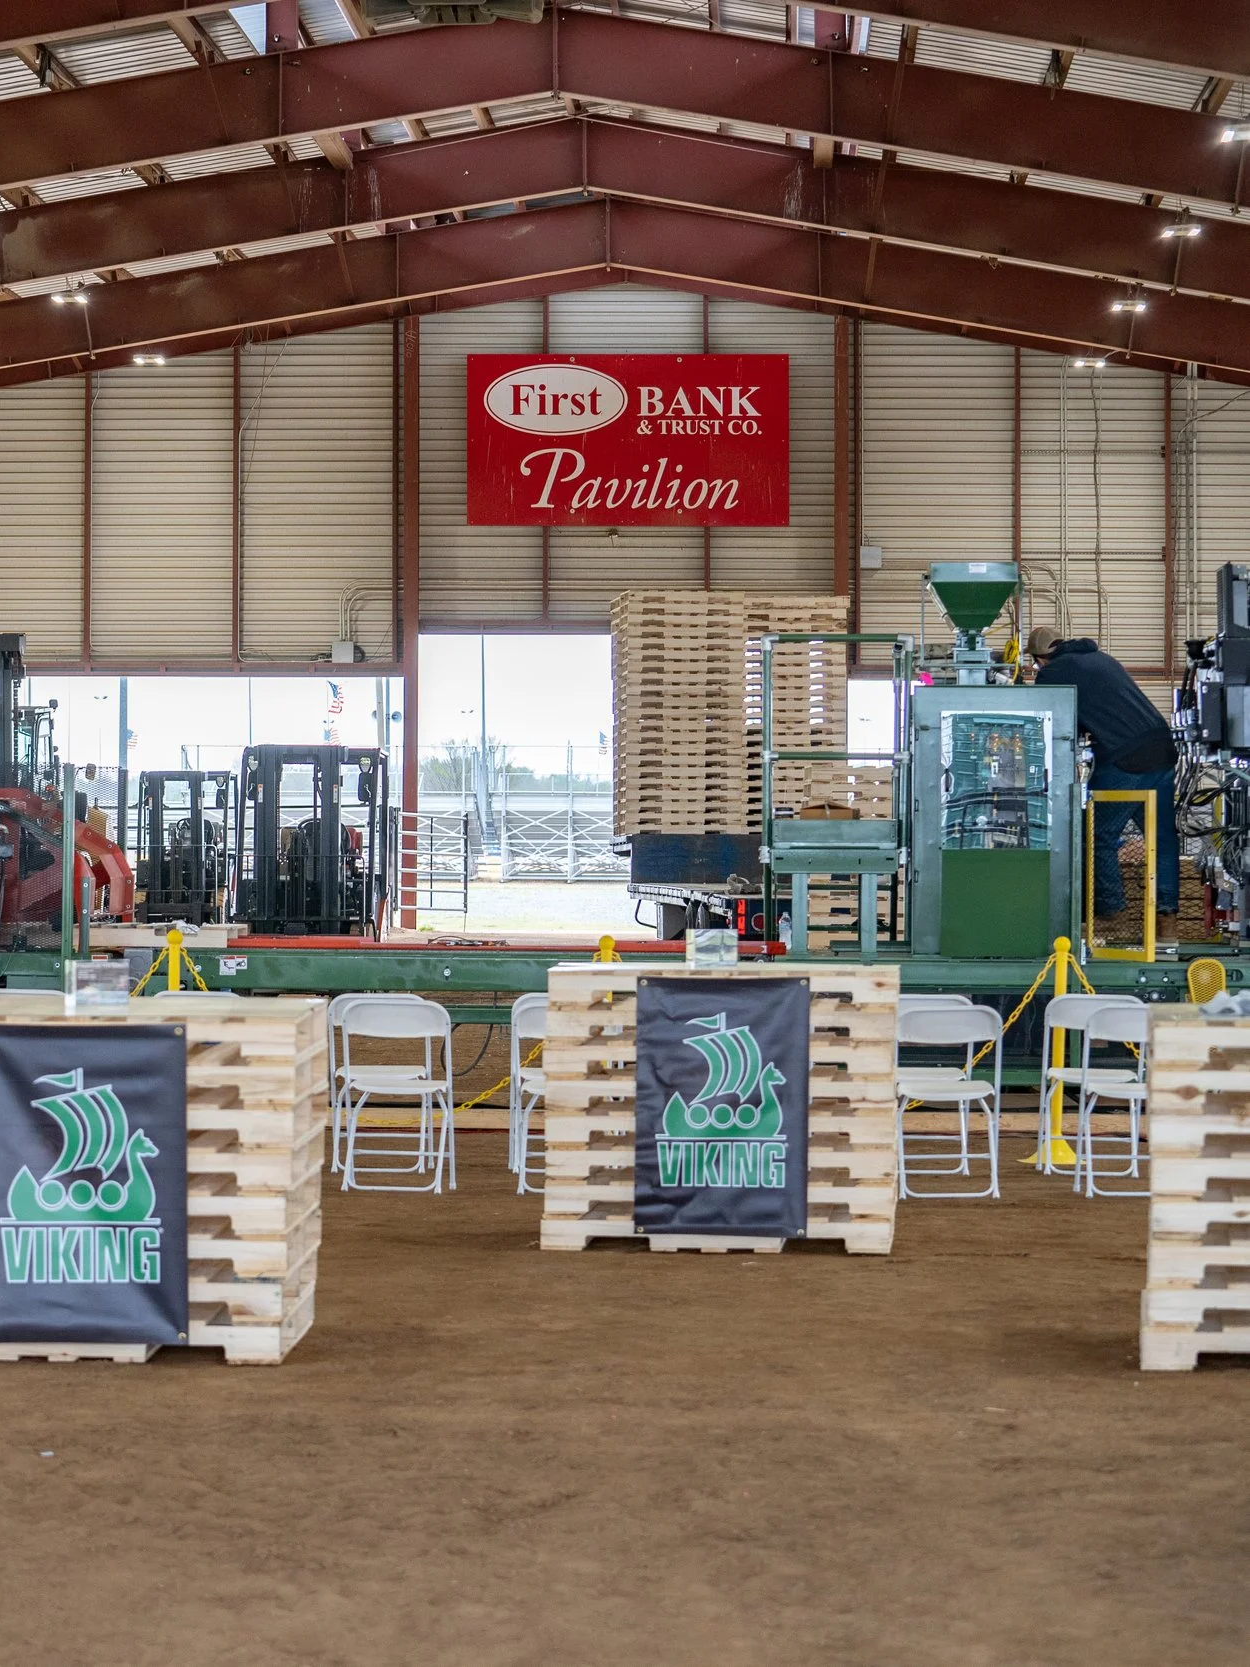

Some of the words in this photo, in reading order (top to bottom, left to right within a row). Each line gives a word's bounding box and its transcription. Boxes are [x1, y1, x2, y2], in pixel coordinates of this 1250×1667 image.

[508, 383, 603, 417] First
[636, 386, 762, 417] BANK
[636, 419, 653, 435] &
[657, 419, 724, 435] TRUST
[727, 419, 763, 435] CO.
[519, 447, 739, 510] Pavilion
[657, 1141, 787, 1188] VIKING
[0, 1226, 162, 1284] VIKING
